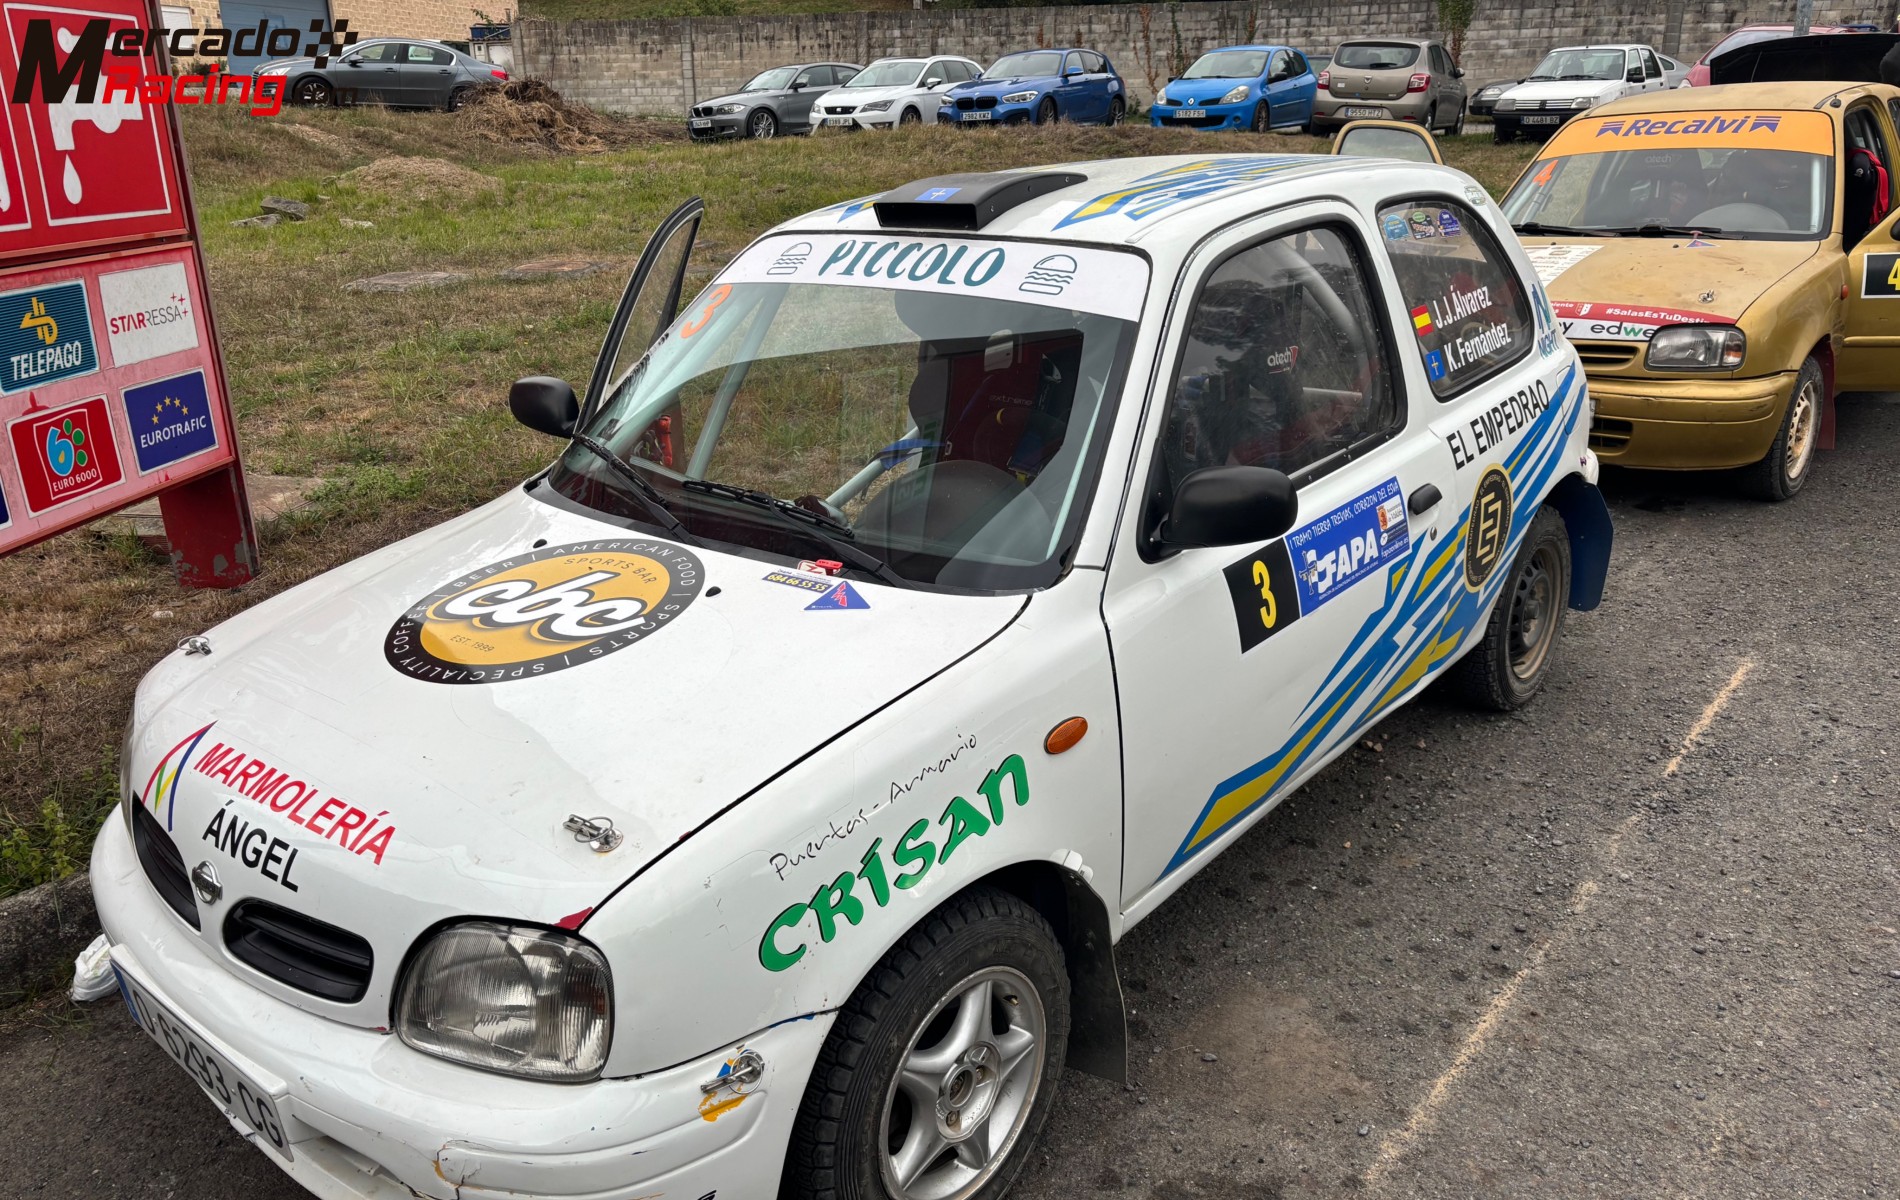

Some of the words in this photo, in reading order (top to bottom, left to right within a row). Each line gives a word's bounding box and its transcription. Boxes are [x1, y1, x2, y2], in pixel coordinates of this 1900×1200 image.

[1622, 115, 1751, 137] Recalvi
[817, 239, 1006, 287] PICCOLO
[109, 305, 183, 335] STARRESSA
[680, 283, 733, 339] 3
[10, 341, 83, 382] TELEPAGO
[140, 415, 208, 449] EUROTRAFIC
[1445, 431, 1475, 471] EL
[1470, 378, 1551, 452] EMPEDRAO
[52, 477, 76, 493] EURO
[75, 467, 98, 485] 6000
[552, 541, 675, 557] AMERICAN
[1317, 528, 1379, 594] FAPA
[453, 559, 517, 588] BEER
[563, 557, 635, 571] SPORTS
[632, 564, 658, 585] BAR
[672, 556, 696, 587] FOOD
[1252, 559, 1277, 630] 3
[392, 602, 434, 655] COFFEE
[471, 641, 495, 653] 1999
[399, 656, 546, 682] SPECIALITY
[193, 742, 396, 866] MARMOLERÍA
[202, 799, 299, 893] ÁNGEL
[157, 1012, 232, 1105] 6293
[237, 1081, 283, 1149] CG
